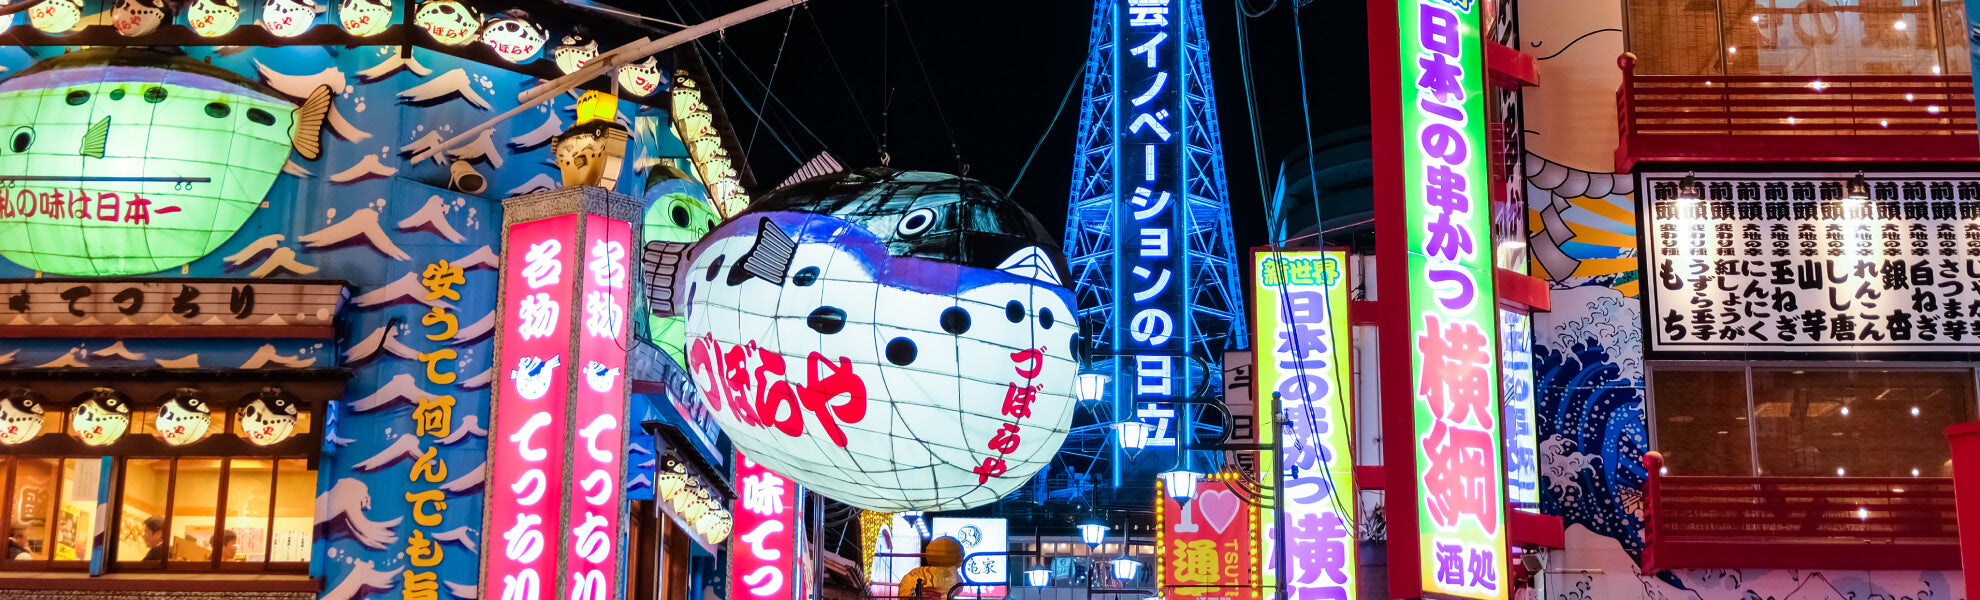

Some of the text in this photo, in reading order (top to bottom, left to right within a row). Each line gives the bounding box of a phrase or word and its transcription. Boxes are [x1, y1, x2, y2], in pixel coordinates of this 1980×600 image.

[1418, 3, 1474, 310] 日本一の串かつ
[1654, 182, 1680, 220] 前頭
[1709, 182, 1736, 220] 前頭
[1736, 182, 1763, 220] 前頭
[1764, 182, 1791, 220] 前頭
[1791, 182, 1818, 220] 前頭
[1819, 182, 1846, 220] 前頭
[1874, 182, 1902, 220] 前頭
[1902, 182, 1930, 220] 前頭
[1930, 182, 1957, 220] 前頭
[518, 239, 562, 340] 名物
[585, 239, 625, 338] 名物
[1262, 259, 1340, 286] 新世界
[1660, 259, 1687, 341] もち
[1687, 259, 1717, 341] うずら玉子
[1714, 259, 1745, 341] 紅しょうが
[1741, 260, 1770, 341] にんにく
[1770, 259, 1800, 341] 玉ねぎ
[1797, 259, 1828, 341] 山芋
[1826, 259, 1856, 341] しし唐
[1853, 259, 1885, 341] れんこん
[1880, 259, 1912, 341] 銀杏
[1910, 259, 1940, 341] 白ねぎ
[1938, 259, 1969, 341] さつま芋
[690, 331, 868, 448] づぼらや
[972, 345, 1048, 485] づぼらや
[1418, 315, 1497, 535] 横綱
[741, 455, 785, 597] 味てつ
[1437, 541, 1497, 590] 酒処
